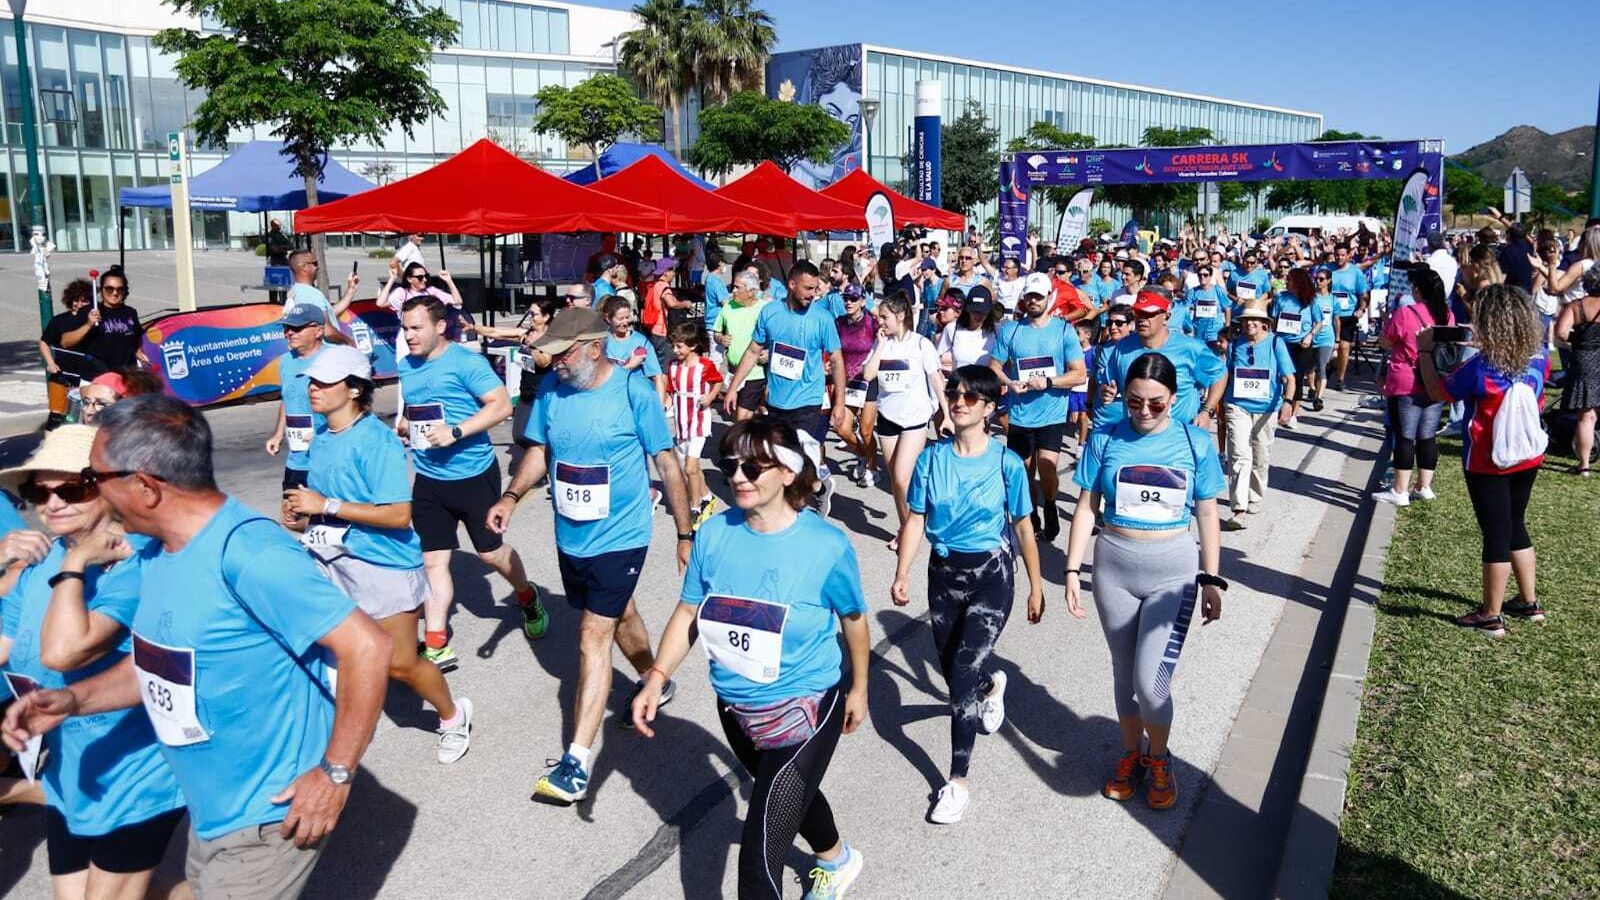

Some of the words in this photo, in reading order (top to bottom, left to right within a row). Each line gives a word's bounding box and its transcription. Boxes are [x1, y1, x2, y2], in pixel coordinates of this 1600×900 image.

[1172, 154, 1228, 165] CARRERA
[1232, 153, 1248, 163] 5K
[925, 183, 932, 191] LA
[925, 192, 932, 201] DE
[187, 335, 248, 355] Ayuntamiento
[250, 332, 260, 343] de
[262, 330, 285, 341] Mála
[191, 356, 213, 368] Área
[214, 353, 225, 364] de
[226, 348, 262, 361] Deporte
[884, 372, 901, 382] 277
[1243, 381, 1260, 389] 692
[566, 488, 592, 503] 618
[1140, 490, 1161, 503] 93
[728, 630, 751, 652] 86
